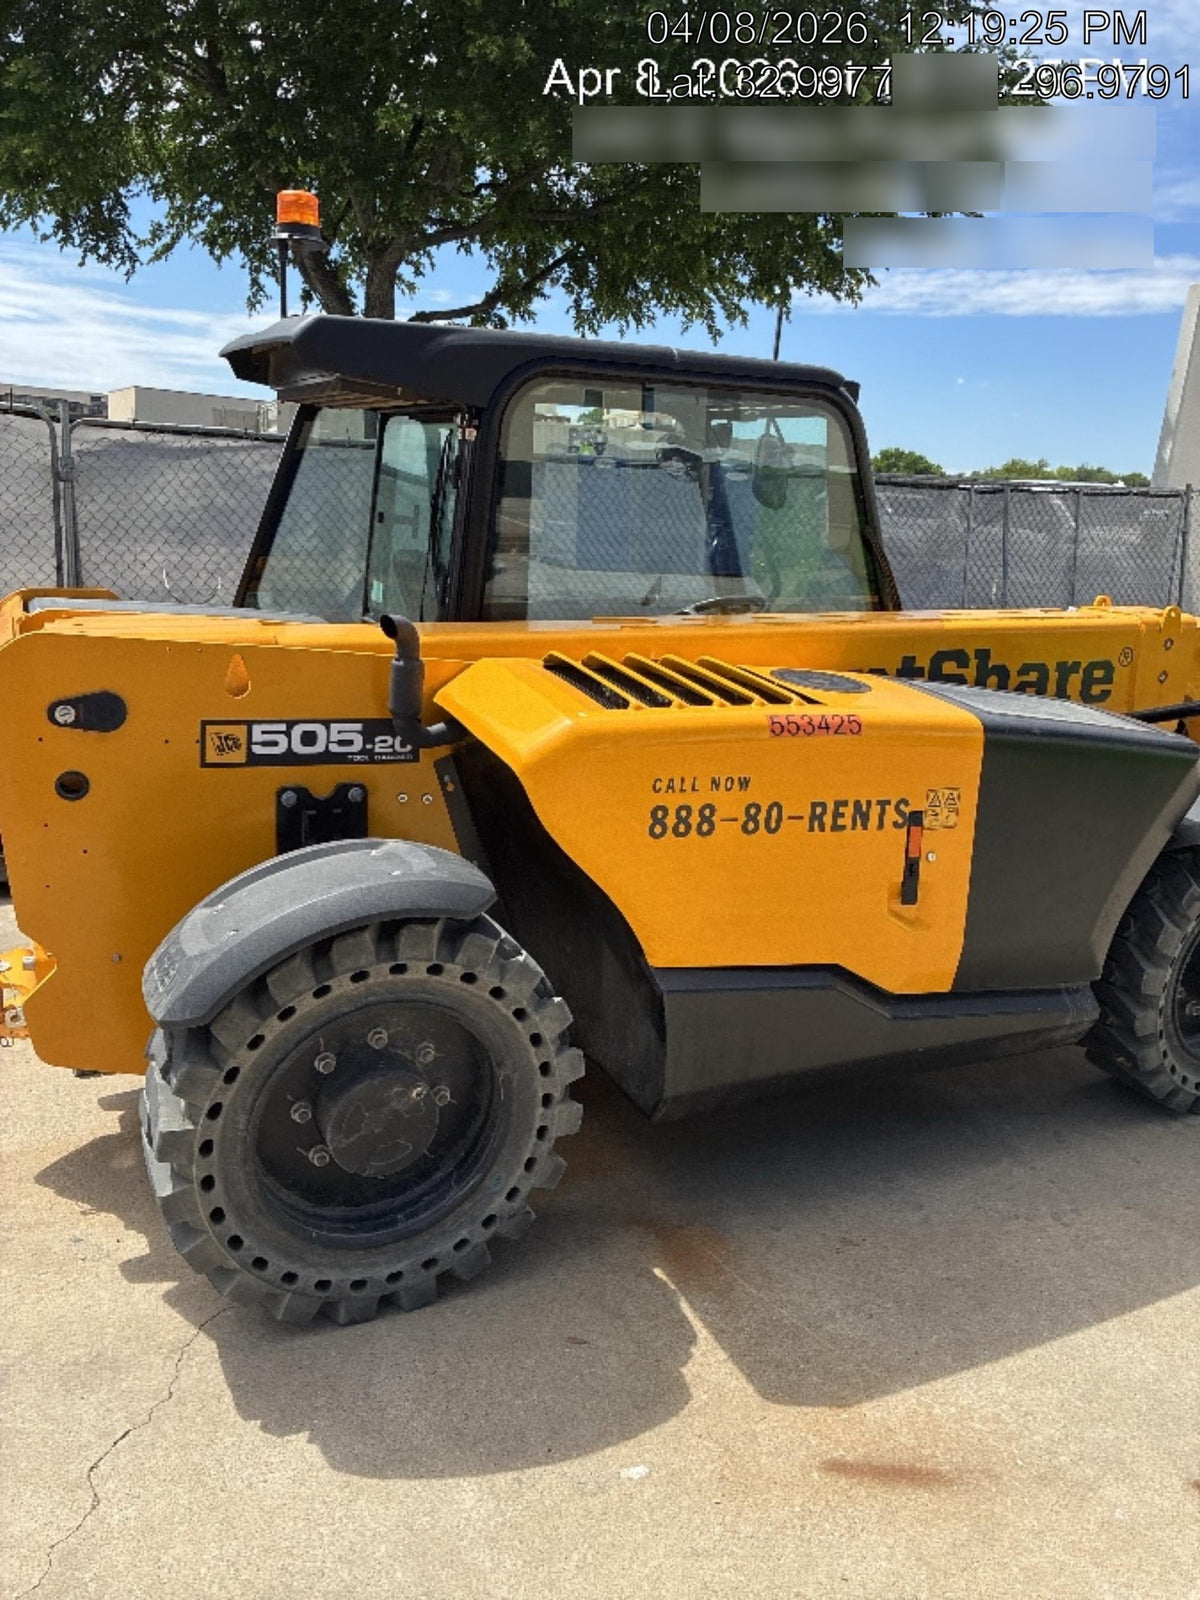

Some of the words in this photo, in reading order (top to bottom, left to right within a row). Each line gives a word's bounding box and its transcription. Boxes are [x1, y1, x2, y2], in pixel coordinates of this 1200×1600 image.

[769, 715, 862, 736] 553425
[652, 777, 700, 794] CALL
[710, 776, 751, 792] NOW
[648, 798, 910, 839] 888-80-RENTS
